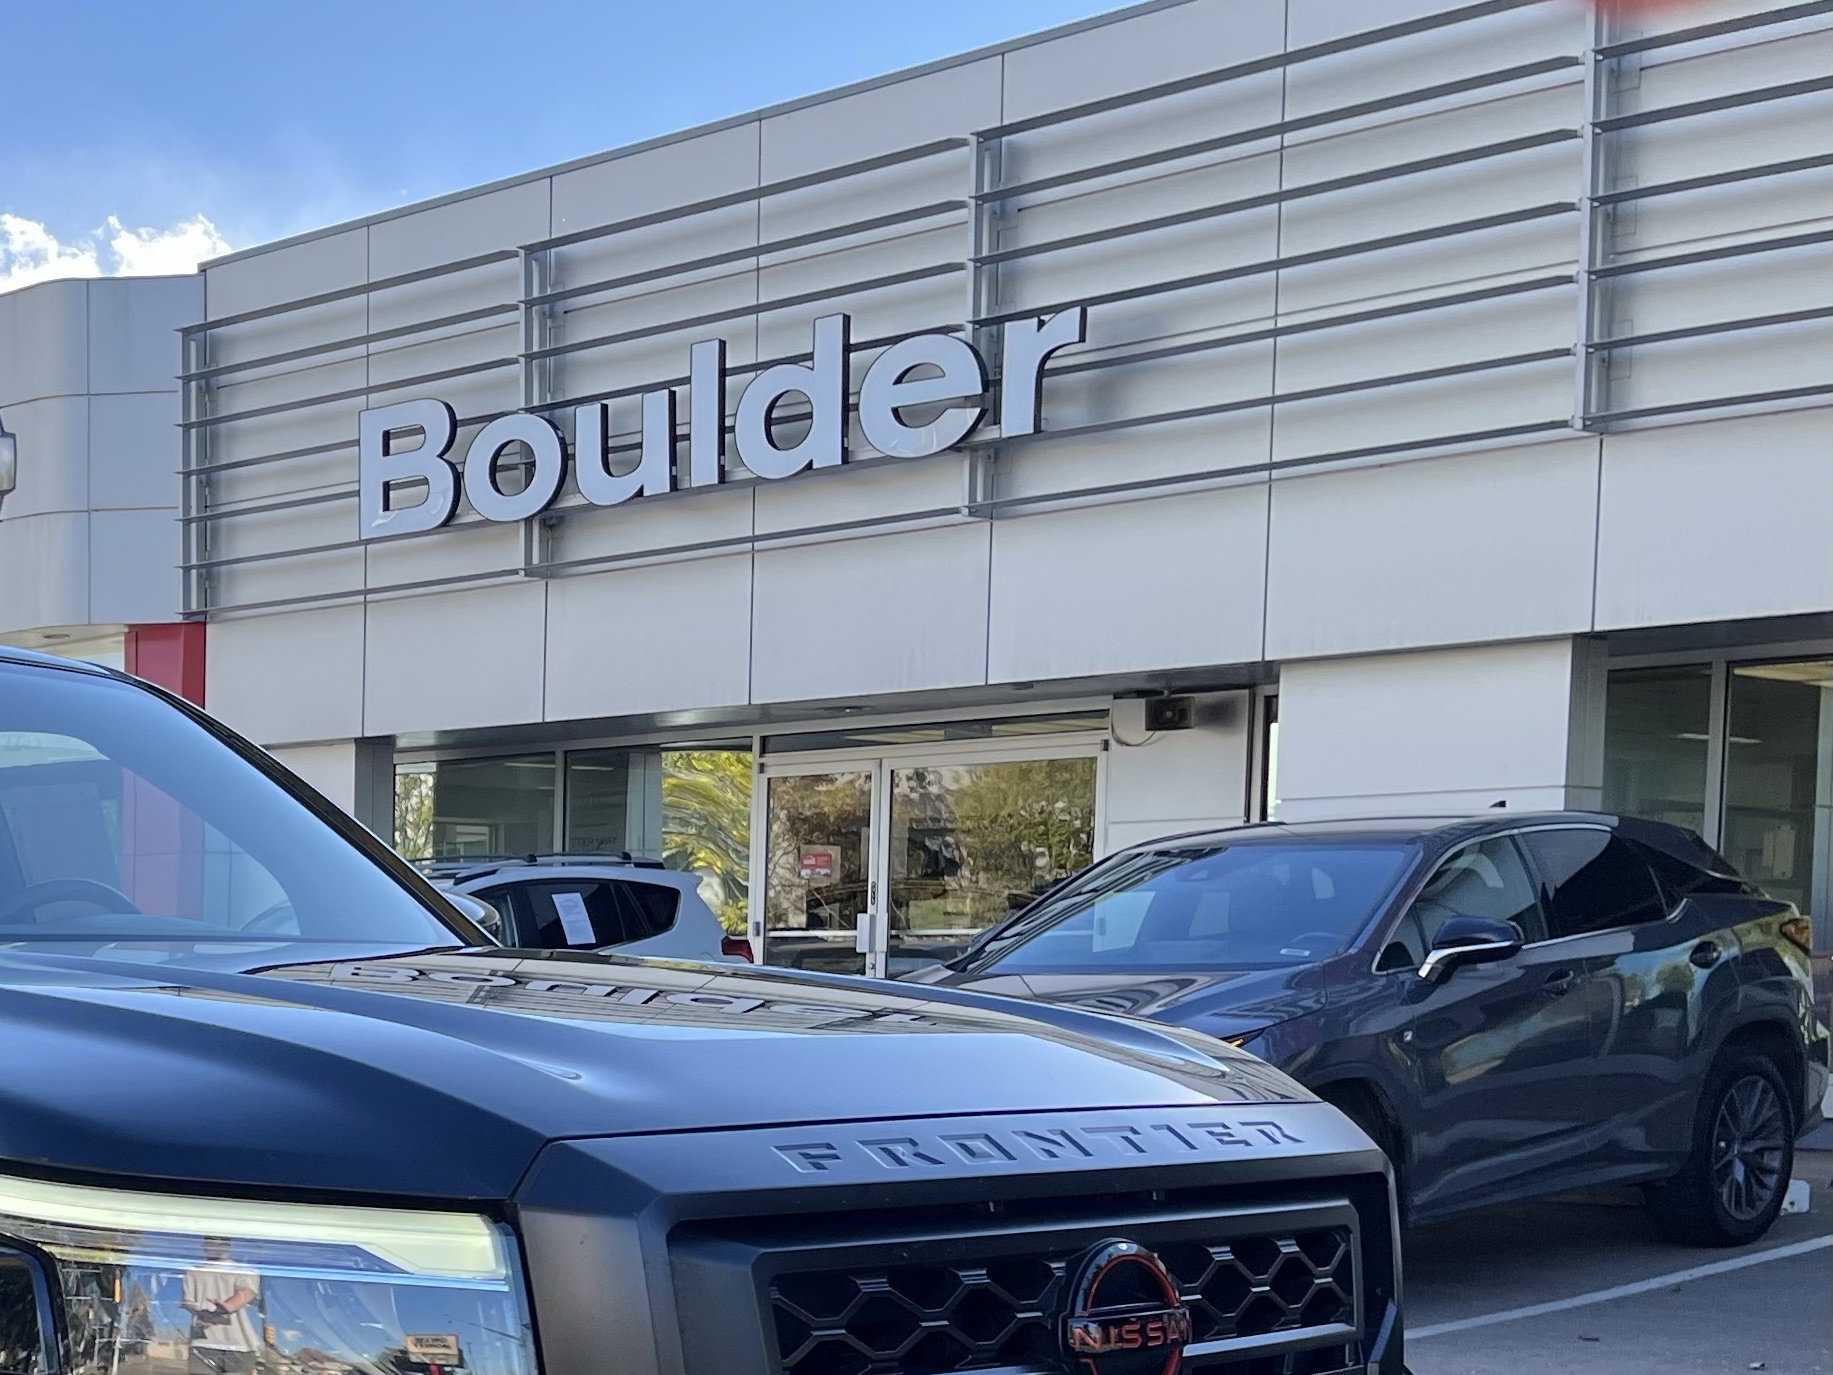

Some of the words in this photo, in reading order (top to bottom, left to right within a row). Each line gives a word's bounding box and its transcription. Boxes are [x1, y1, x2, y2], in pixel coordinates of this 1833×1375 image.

[359, 306, 1087, 541] Boulder
[770, 1119, 1306, 1173] FRONTIER
[1072, 1316, 1192, 1352] NISSAN
